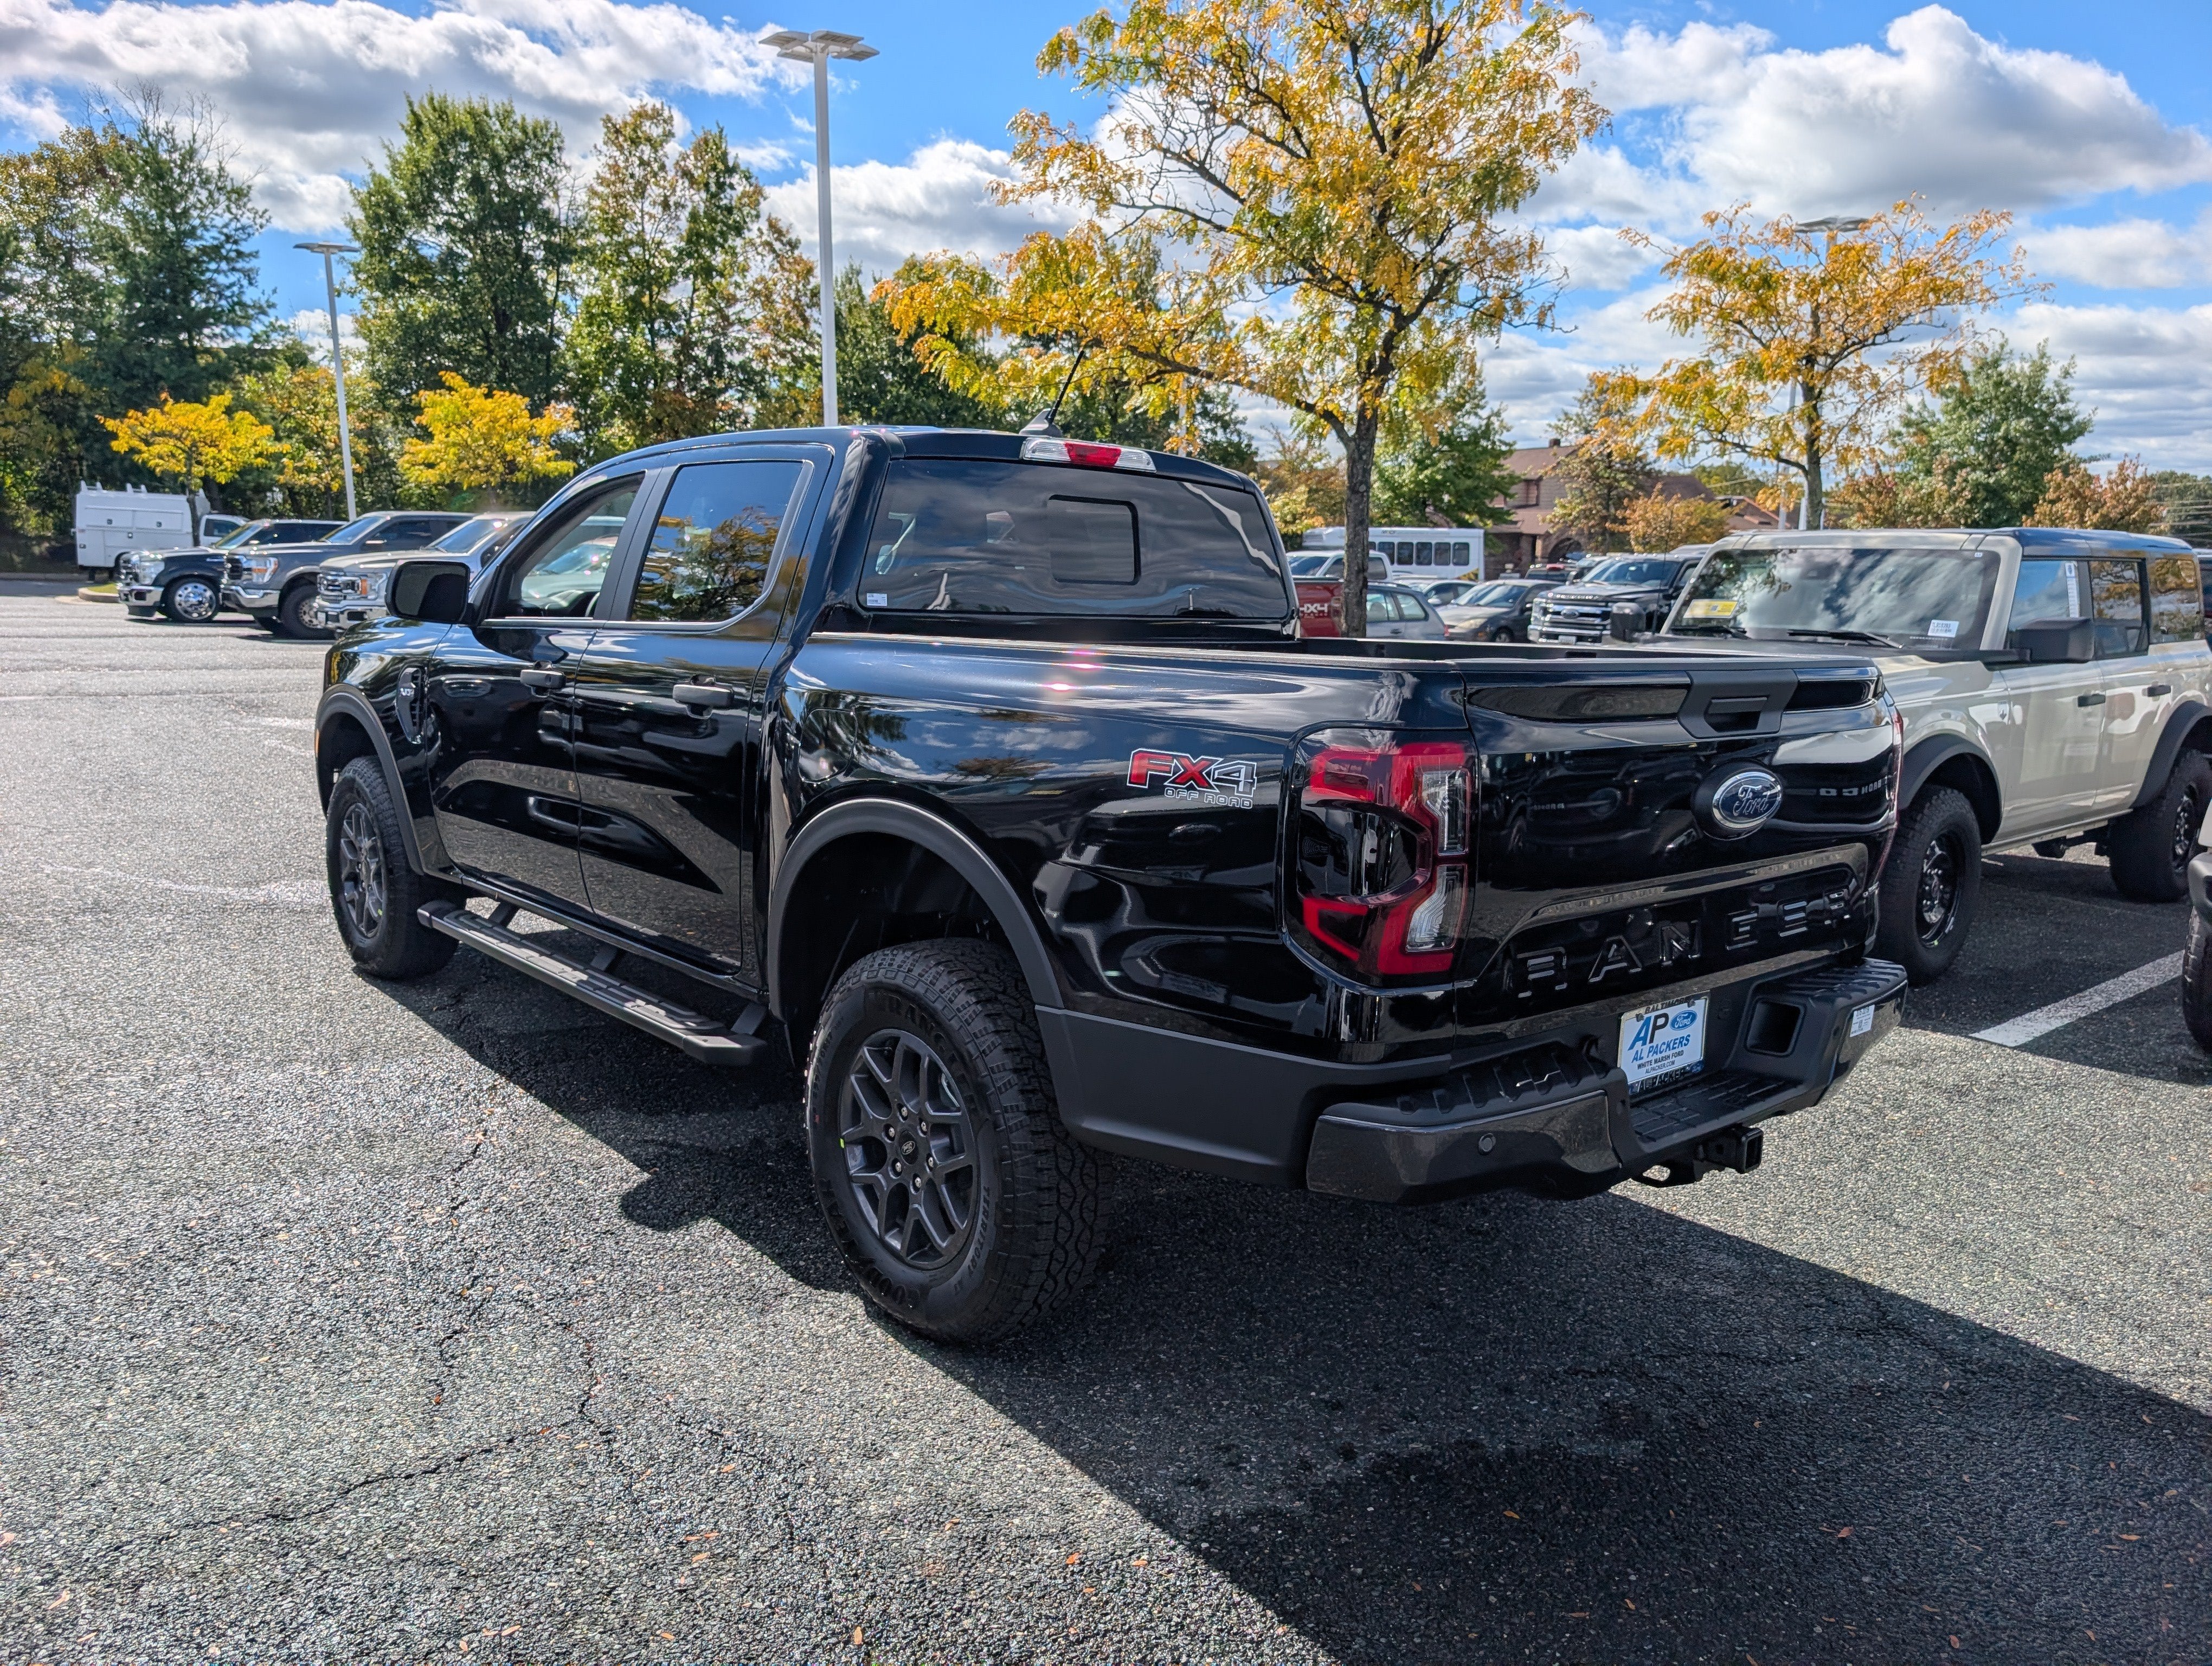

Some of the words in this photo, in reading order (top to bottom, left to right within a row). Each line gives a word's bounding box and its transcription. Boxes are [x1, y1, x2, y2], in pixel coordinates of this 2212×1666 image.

[1127, 748, 1257, 797] FX4
[1164, 787, 1199, 801] OFF
[1204, 792, 1253, 809] ROAD
[1733, 784, 1769, 817] Ford
[1516, 889, 1851, 999] RANGER
[1627, 1012, 1669, 1051] AP
[1674, 1013, 1692, 1029] Ford
[1631, 1050, 1644, 1063] AL
[1647, 1034, 1691, 1059] PACKERS
[1637, 1059, 1652, 1070] WHITE
[1654, 1054, 1670, 1065] MARSH
[1671, 1050, 1684, 1060] FORD
[1644, 1060, 1675, 1074] ALPACKER.COM
[967, 1185, 991, 1277] TERRITORY
